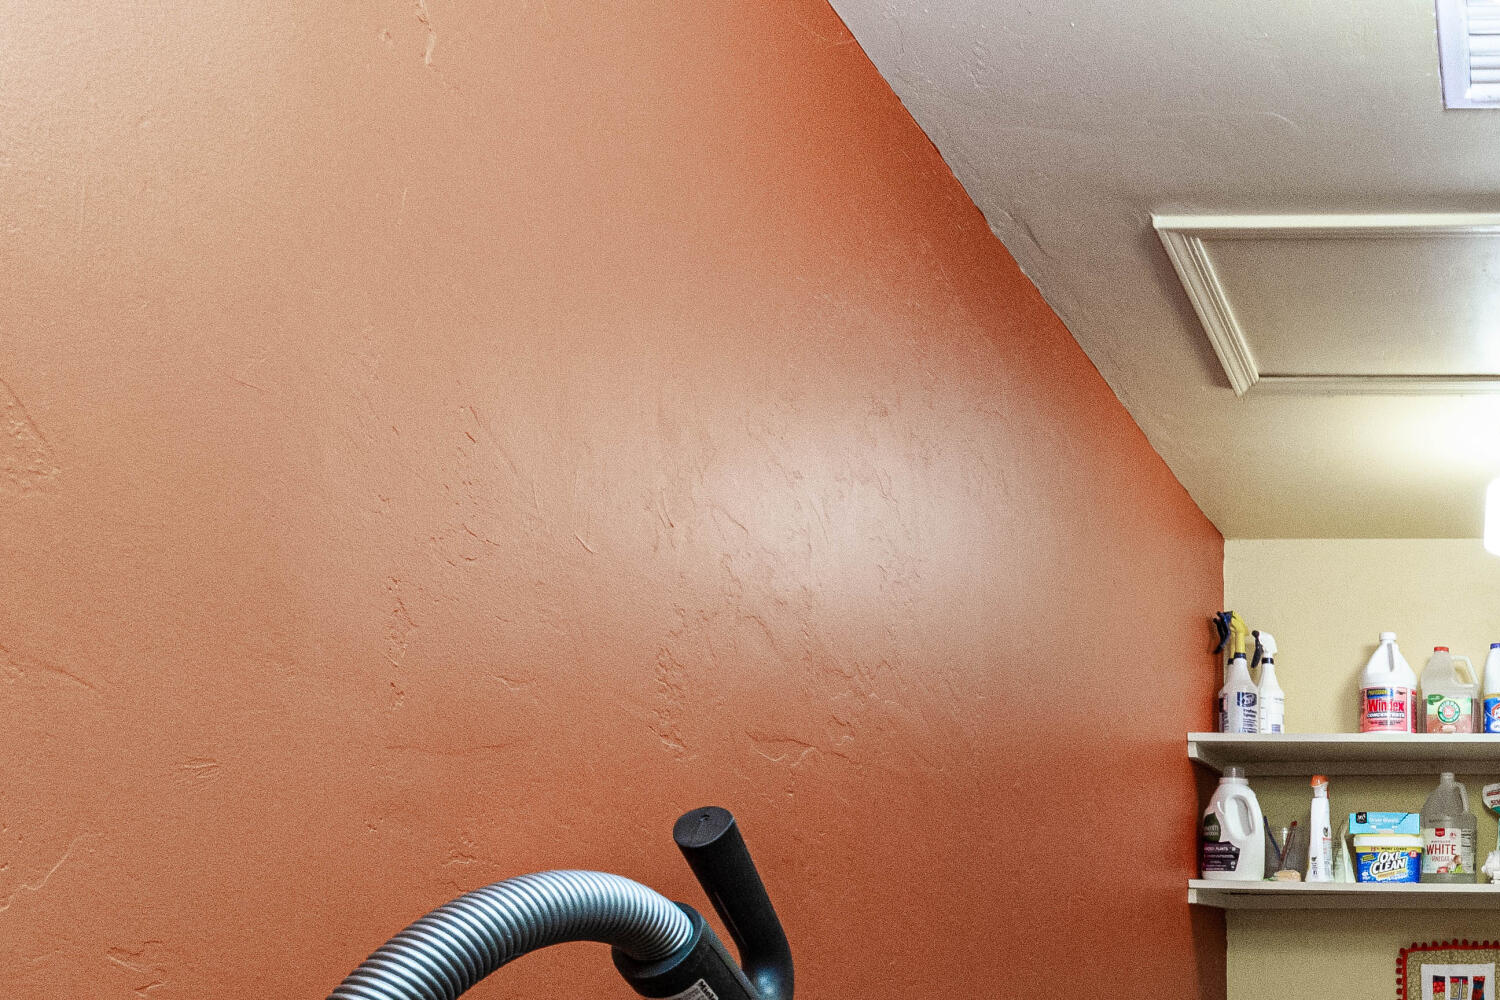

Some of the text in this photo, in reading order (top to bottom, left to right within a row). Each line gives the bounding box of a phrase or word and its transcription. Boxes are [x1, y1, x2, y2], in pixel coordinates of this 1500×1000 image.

[1426, 844, 1457, 855] WHITE
[1380, 852, 1400, 863] OXI
[1372, 858, 1406, 874] CLEAN
